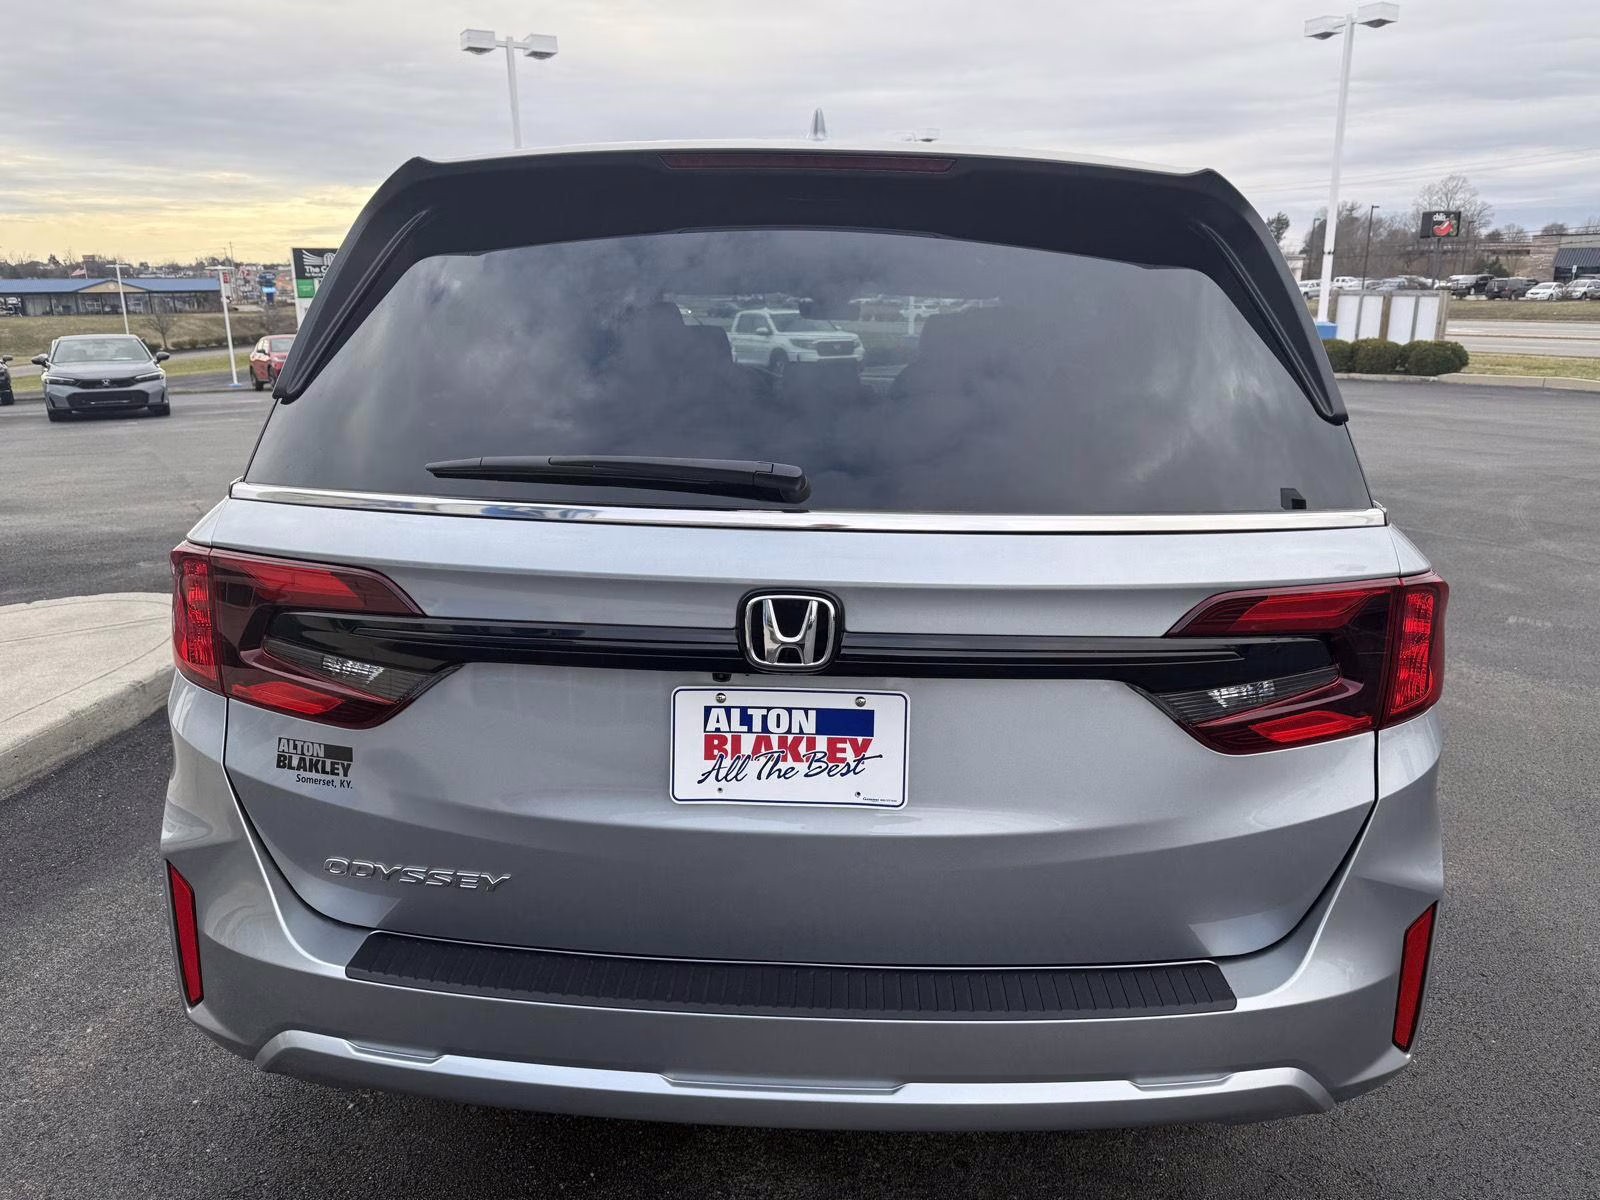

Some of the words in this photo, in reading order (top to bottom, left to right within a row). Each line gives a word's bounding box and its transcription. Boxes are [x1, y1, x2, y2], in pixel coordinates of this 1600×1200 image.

[304, 265, 320, 273] The
[705, 708, 816, 734] ALTON
[278, 738, 325, 758] ALTON
[704, 734, 873, 764] BLAKLEY
[276, 754, 352, 777] BLAKLEY
[697, 754, 752, 785] All
[754, 750, 800, 781] The
[802, 751, 883, 778] Best
[295, 773, 337, 789] Somerset,
[340, 779, 353, 790] KY.
[323, 856, 512, 892] ODYSSEY
